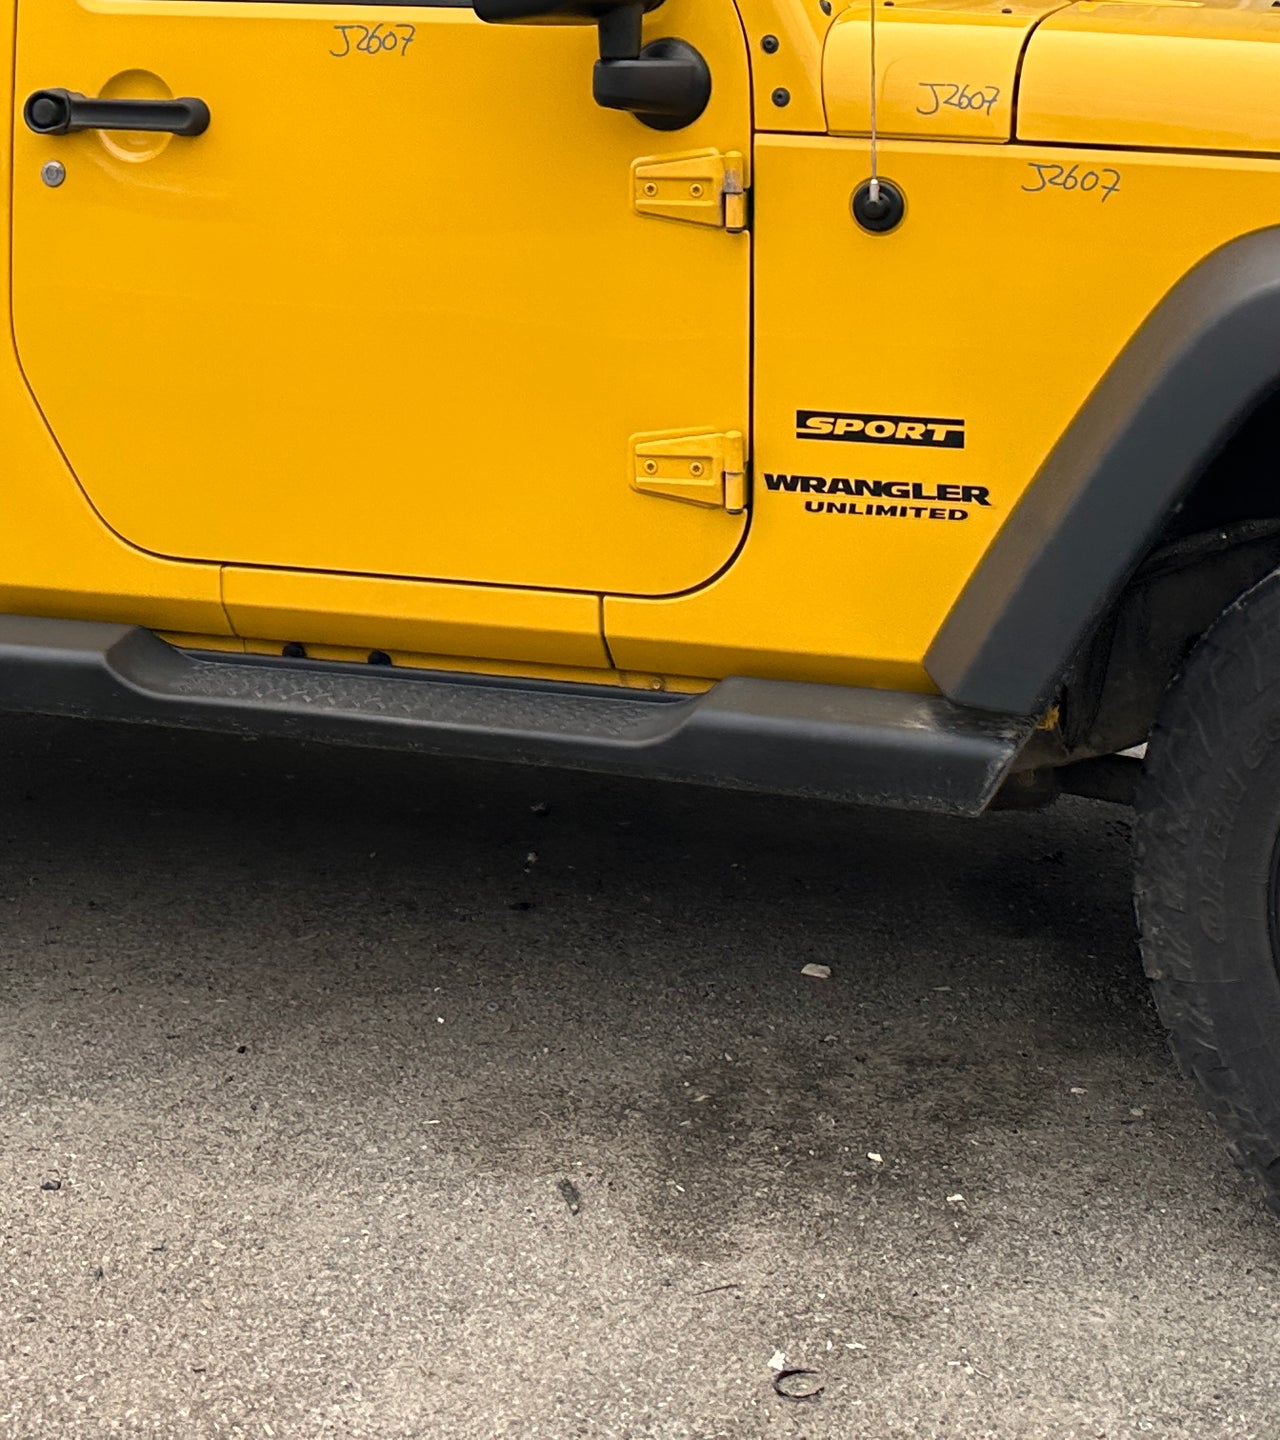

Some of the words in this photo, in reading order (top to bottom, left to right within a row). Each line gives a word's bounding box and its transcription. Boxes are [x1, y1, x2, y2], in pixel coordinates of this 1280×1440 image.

[329, 23, 417, 58] J2607
[916, 82, 1001, 116] J2607
[1021, 162, 1121, 203] J2607
[805, 416, 950, 442] SPORT
[763, 473, 992, 506] WRANGLER
[804, 501, 969, 521] UNLIMITED
